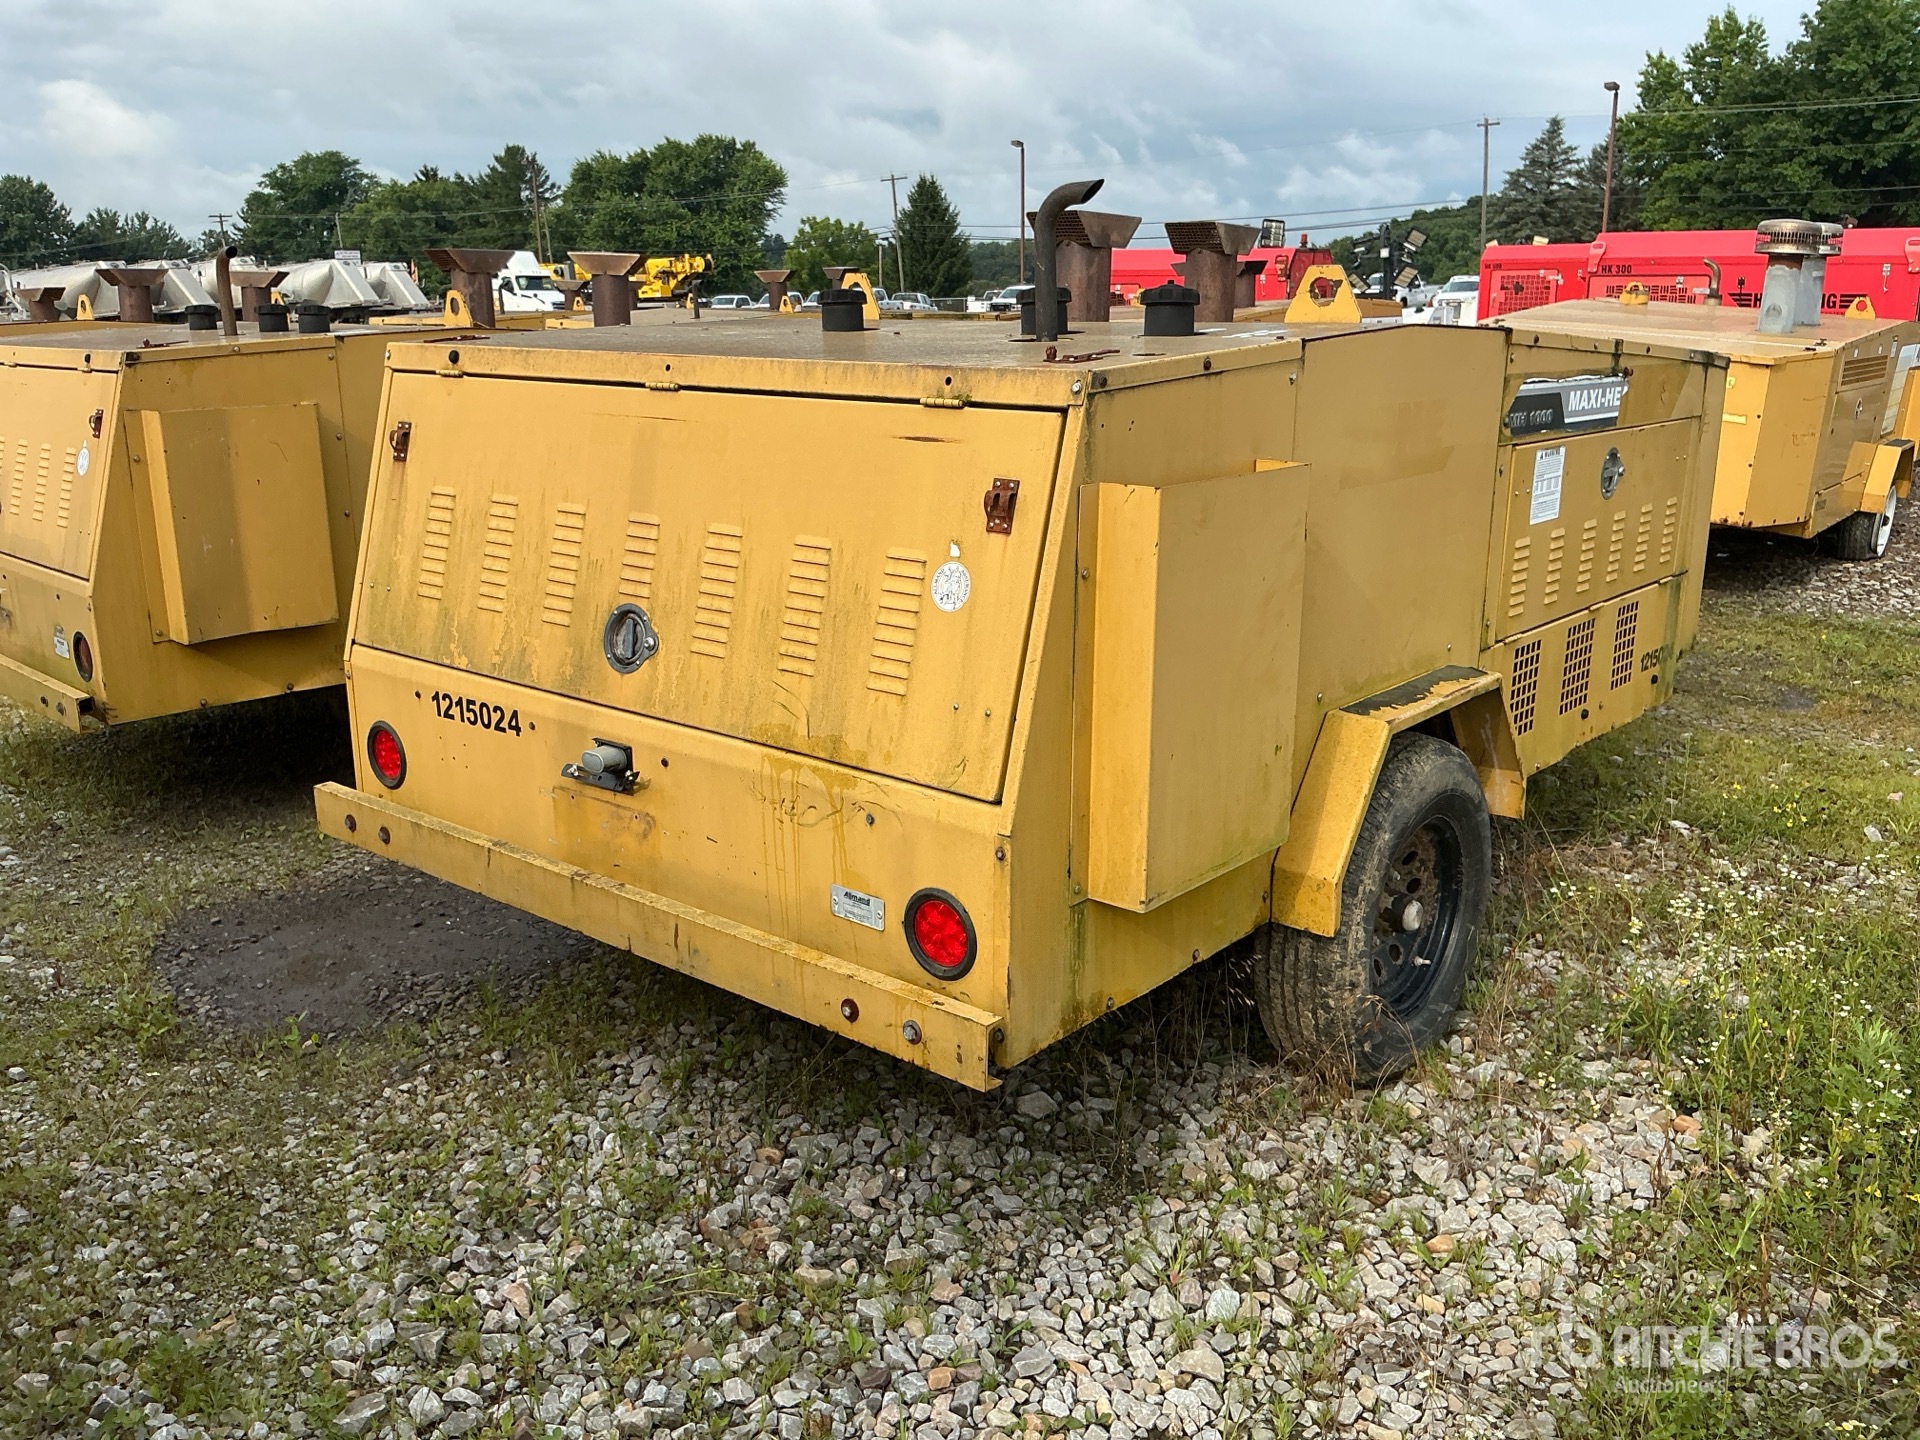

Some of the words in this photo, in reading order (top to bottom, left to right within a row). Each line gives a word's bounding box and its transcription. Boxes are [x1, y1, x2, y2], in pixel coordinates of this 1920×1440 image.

[1601, 264, 1613, 274] HK
[1615, 264, 1632, 274] 300
[432, 691, 521, 737] 1215024
[844, 891, 871, 906] Allmand
